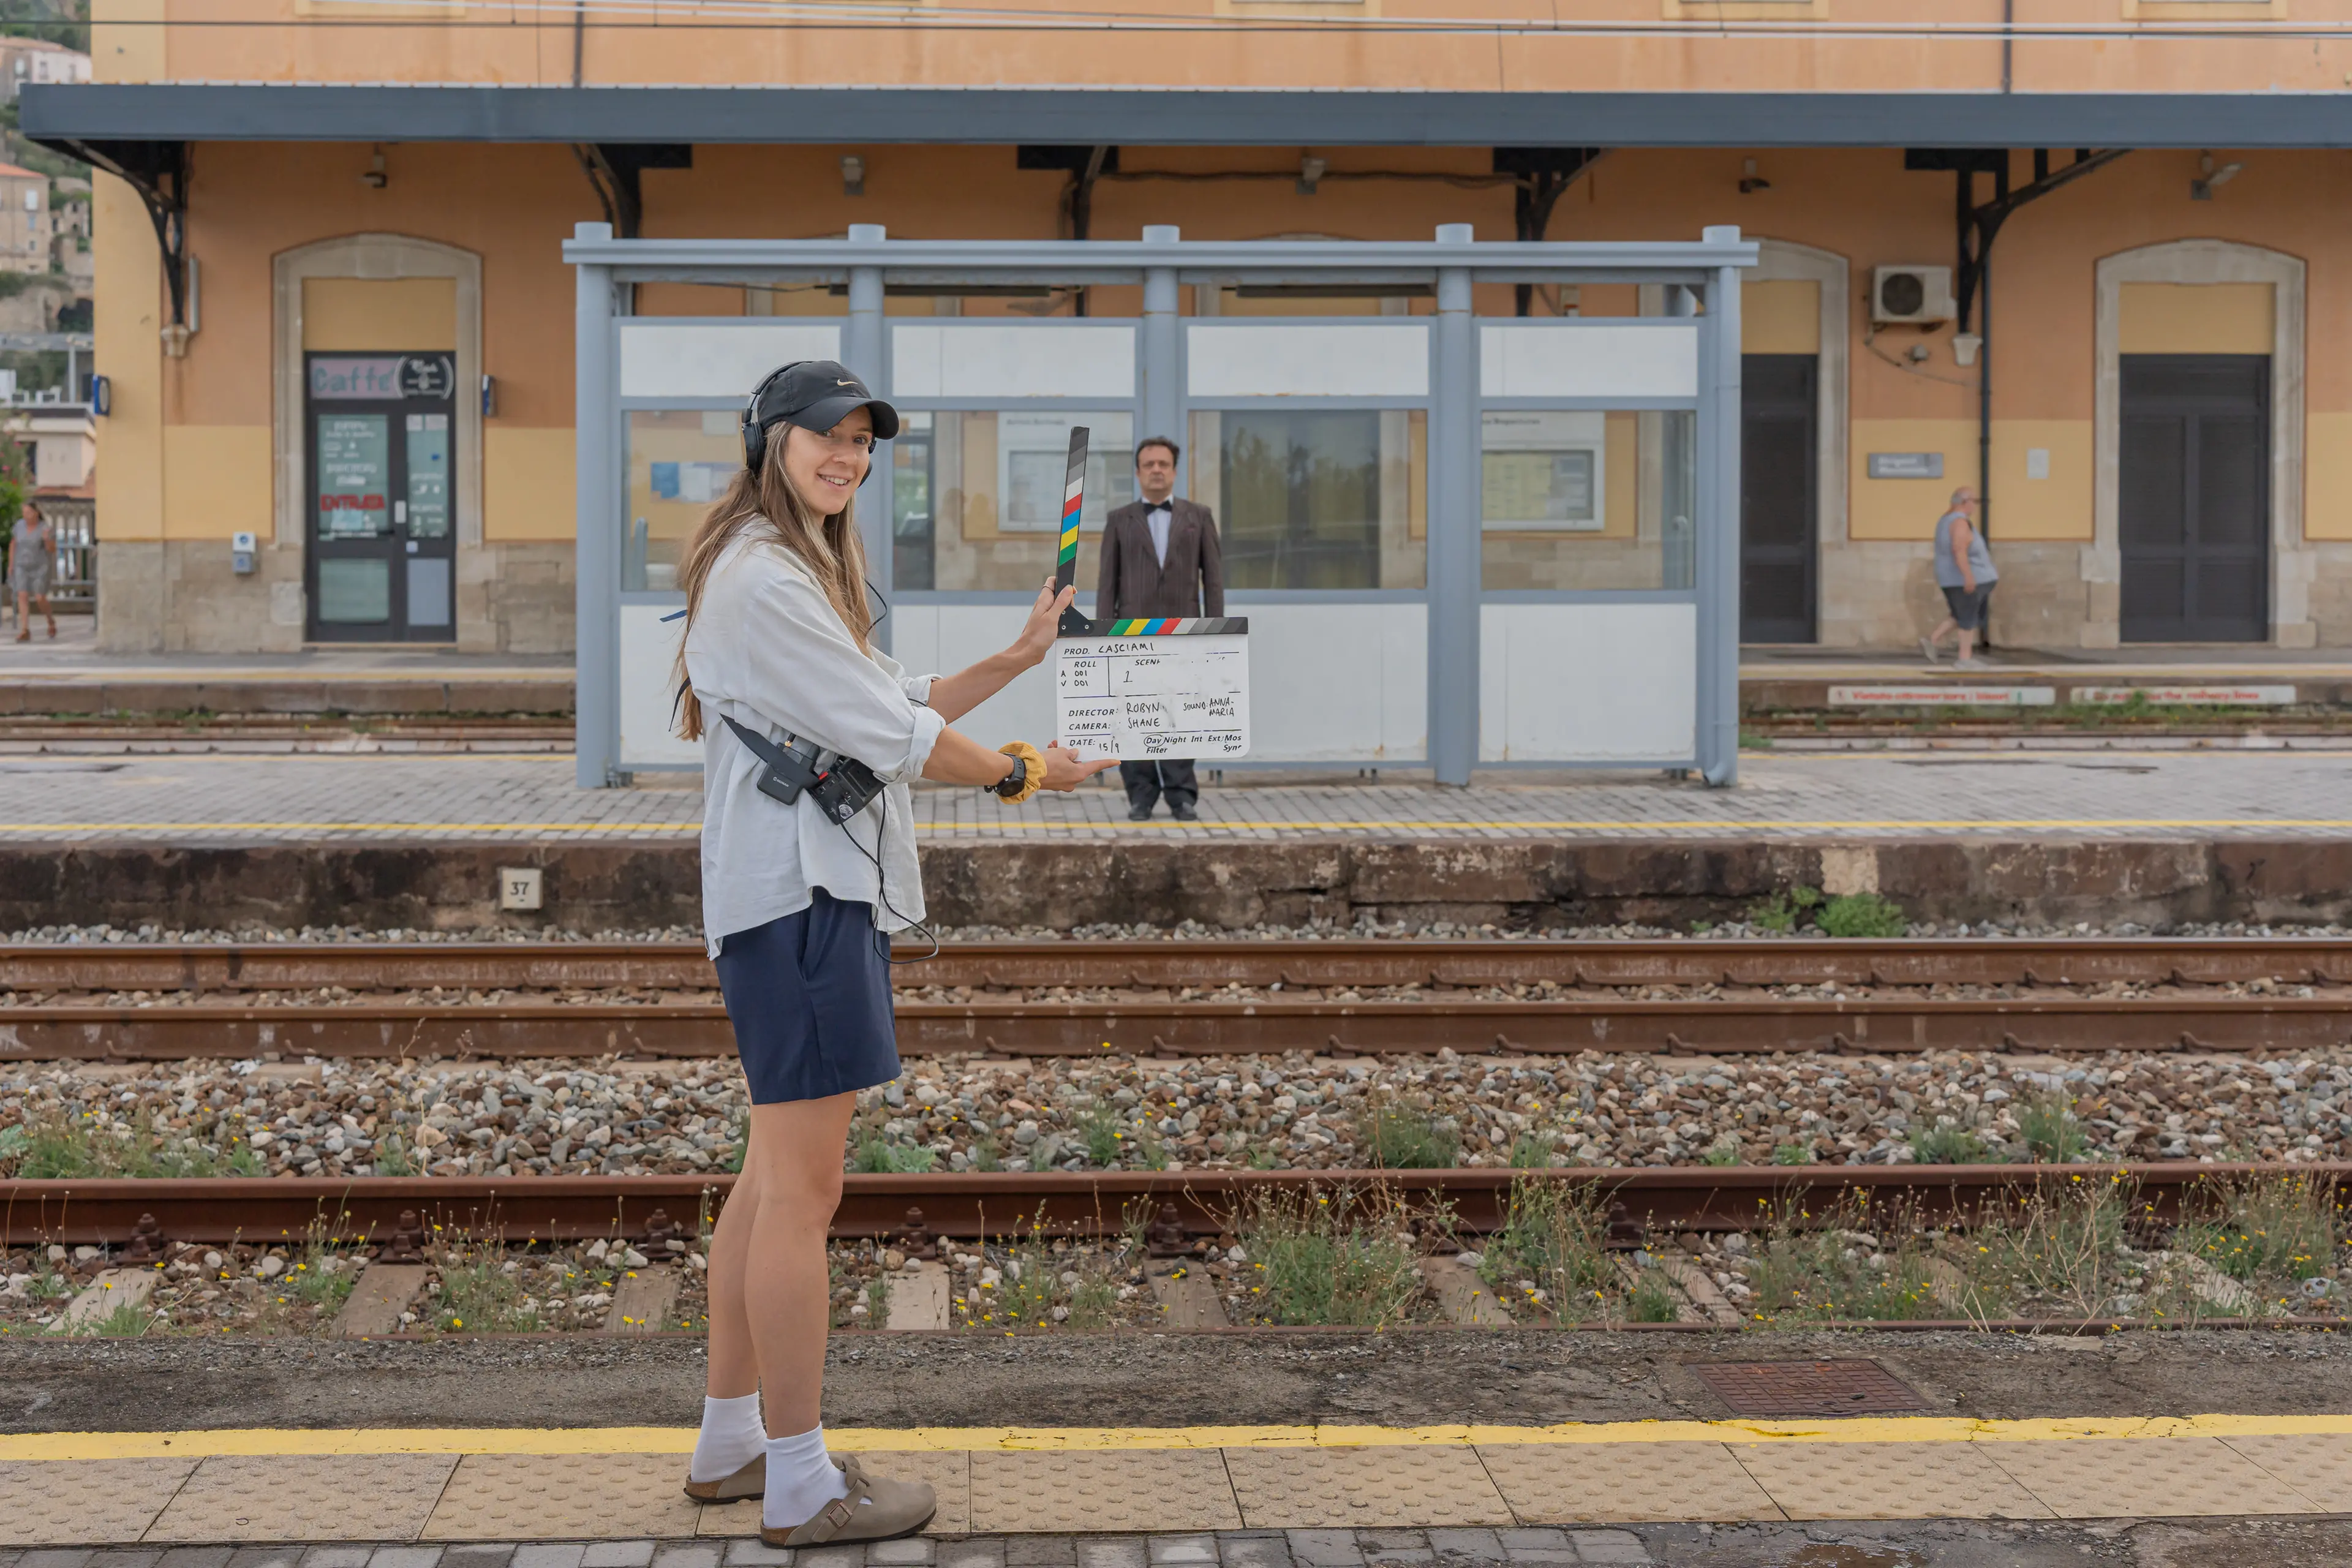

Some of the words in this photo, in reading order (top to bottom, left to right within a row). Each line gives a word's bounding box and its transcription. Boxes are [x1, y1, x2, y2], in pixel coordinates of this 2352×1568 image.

[1123, 671, 1133, 682] 1
[1126, 702, 1160, 715] ROBYN
[1209, 707, 1235, 717] MARIA
[1128, 717, 1161, 729] SHANE
[510, 881, 530, 895] 37
